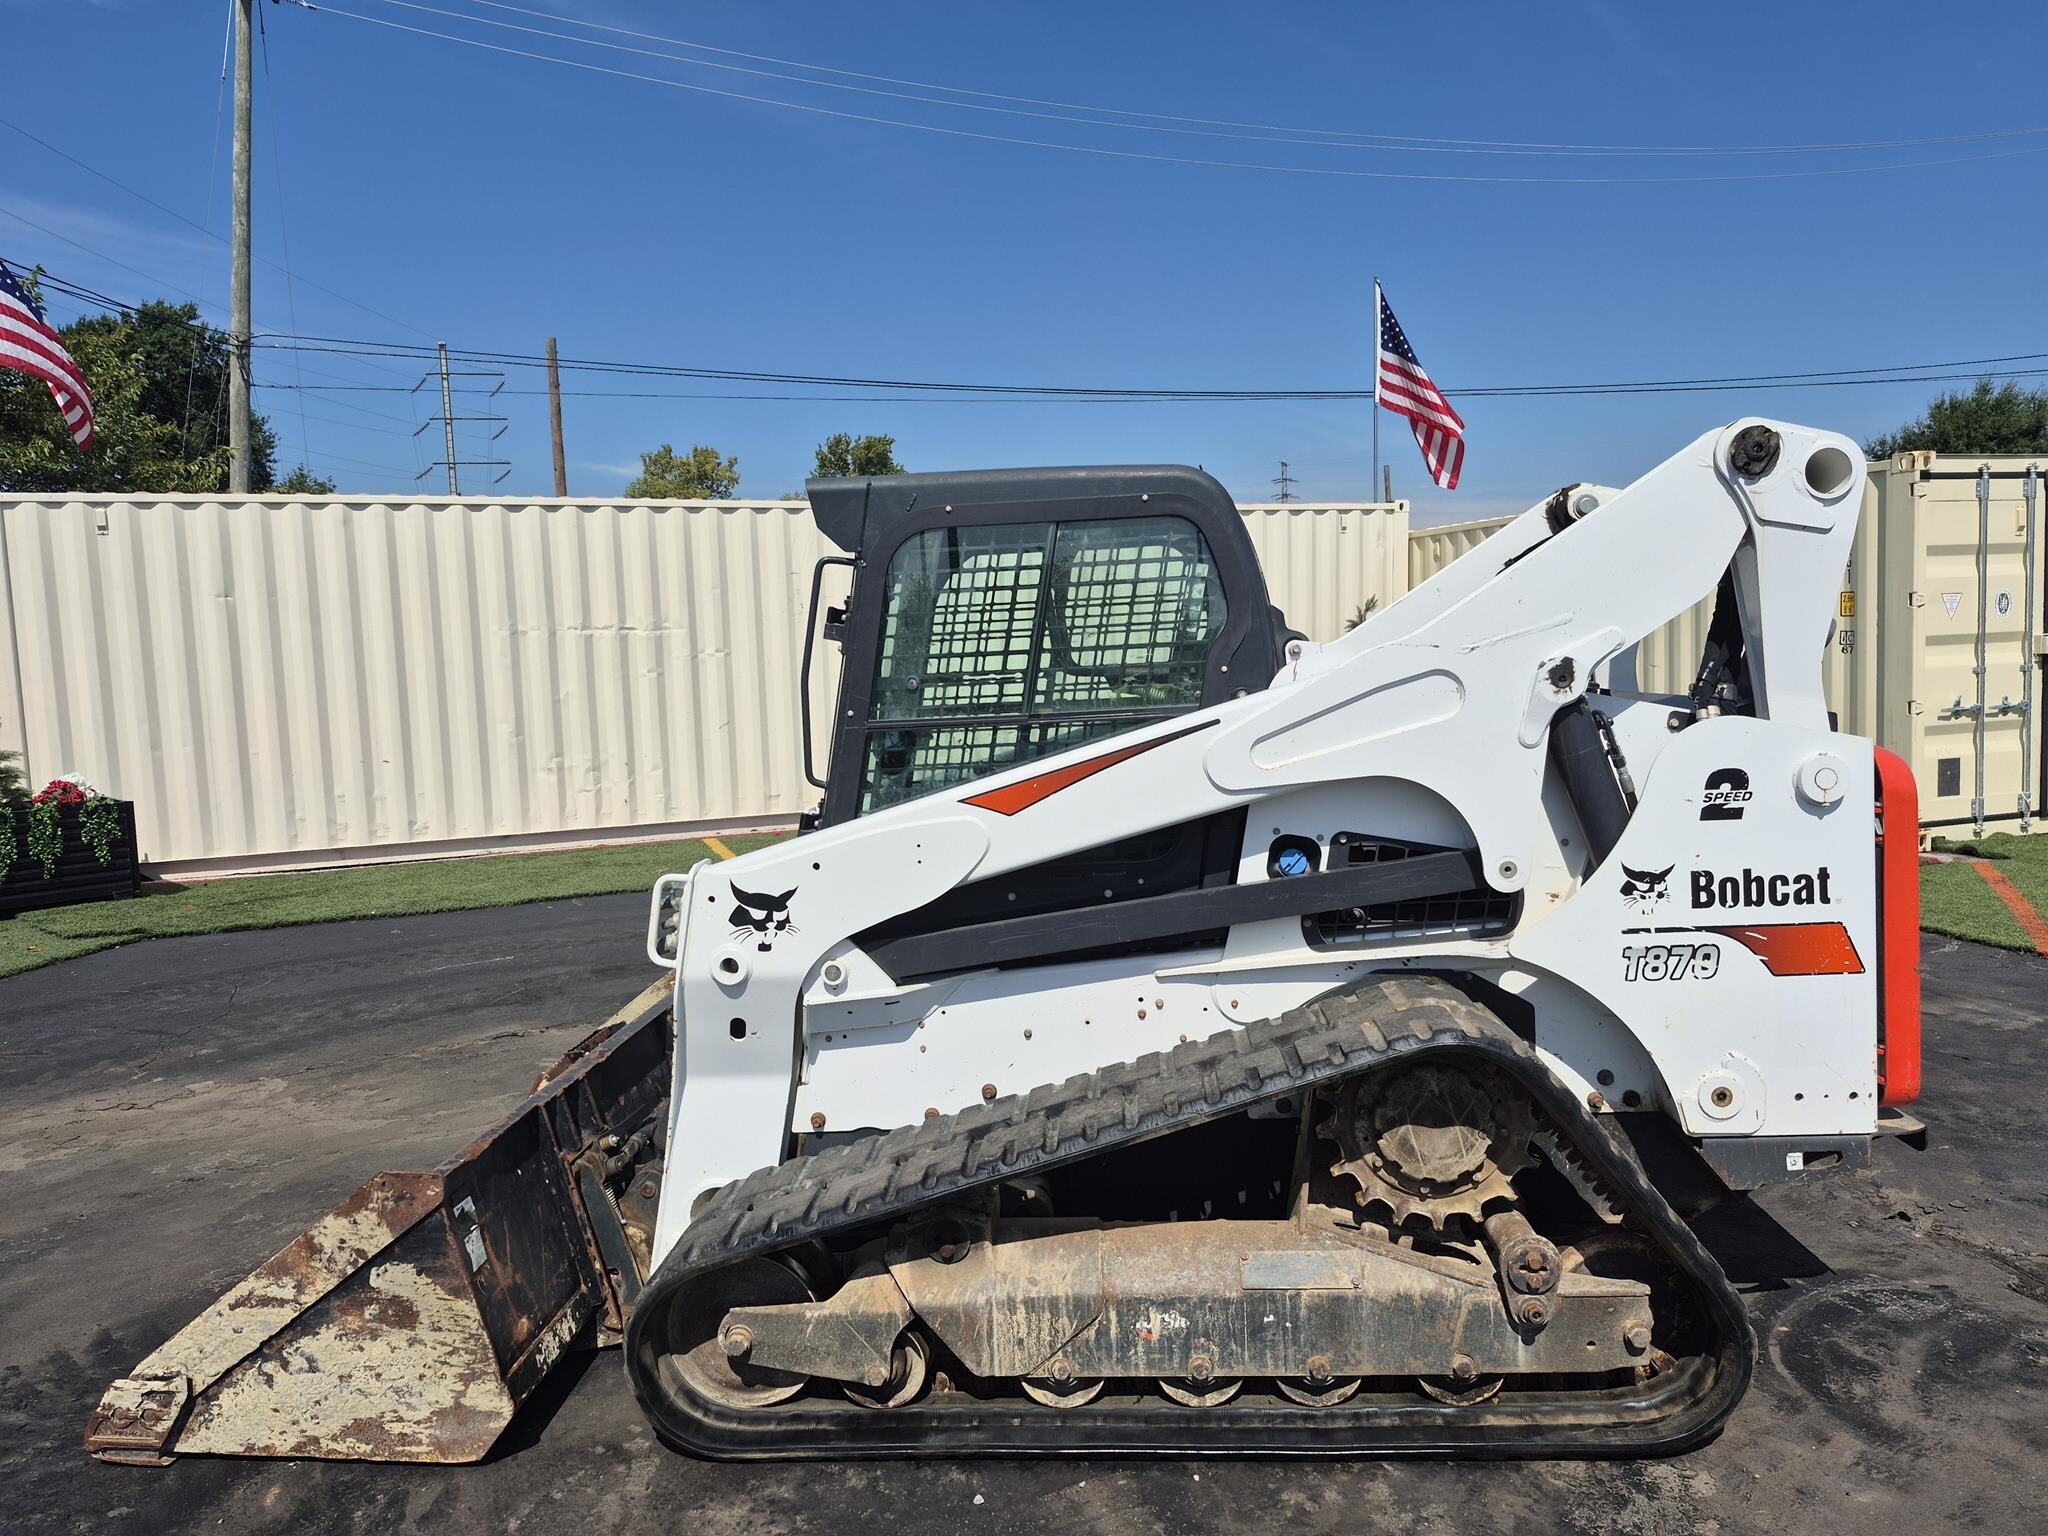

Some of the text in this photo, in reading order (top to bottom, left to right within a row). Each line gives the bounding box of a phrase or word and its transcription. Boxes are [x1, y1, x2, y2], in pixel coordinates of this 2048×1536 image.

[1841, 645, 1854, 655] 87
[1700, 768, 1749, 821] 2
[1703, 791, 1753, 803] SPEED
[1691, 867, 1831, 909] Bobcat
